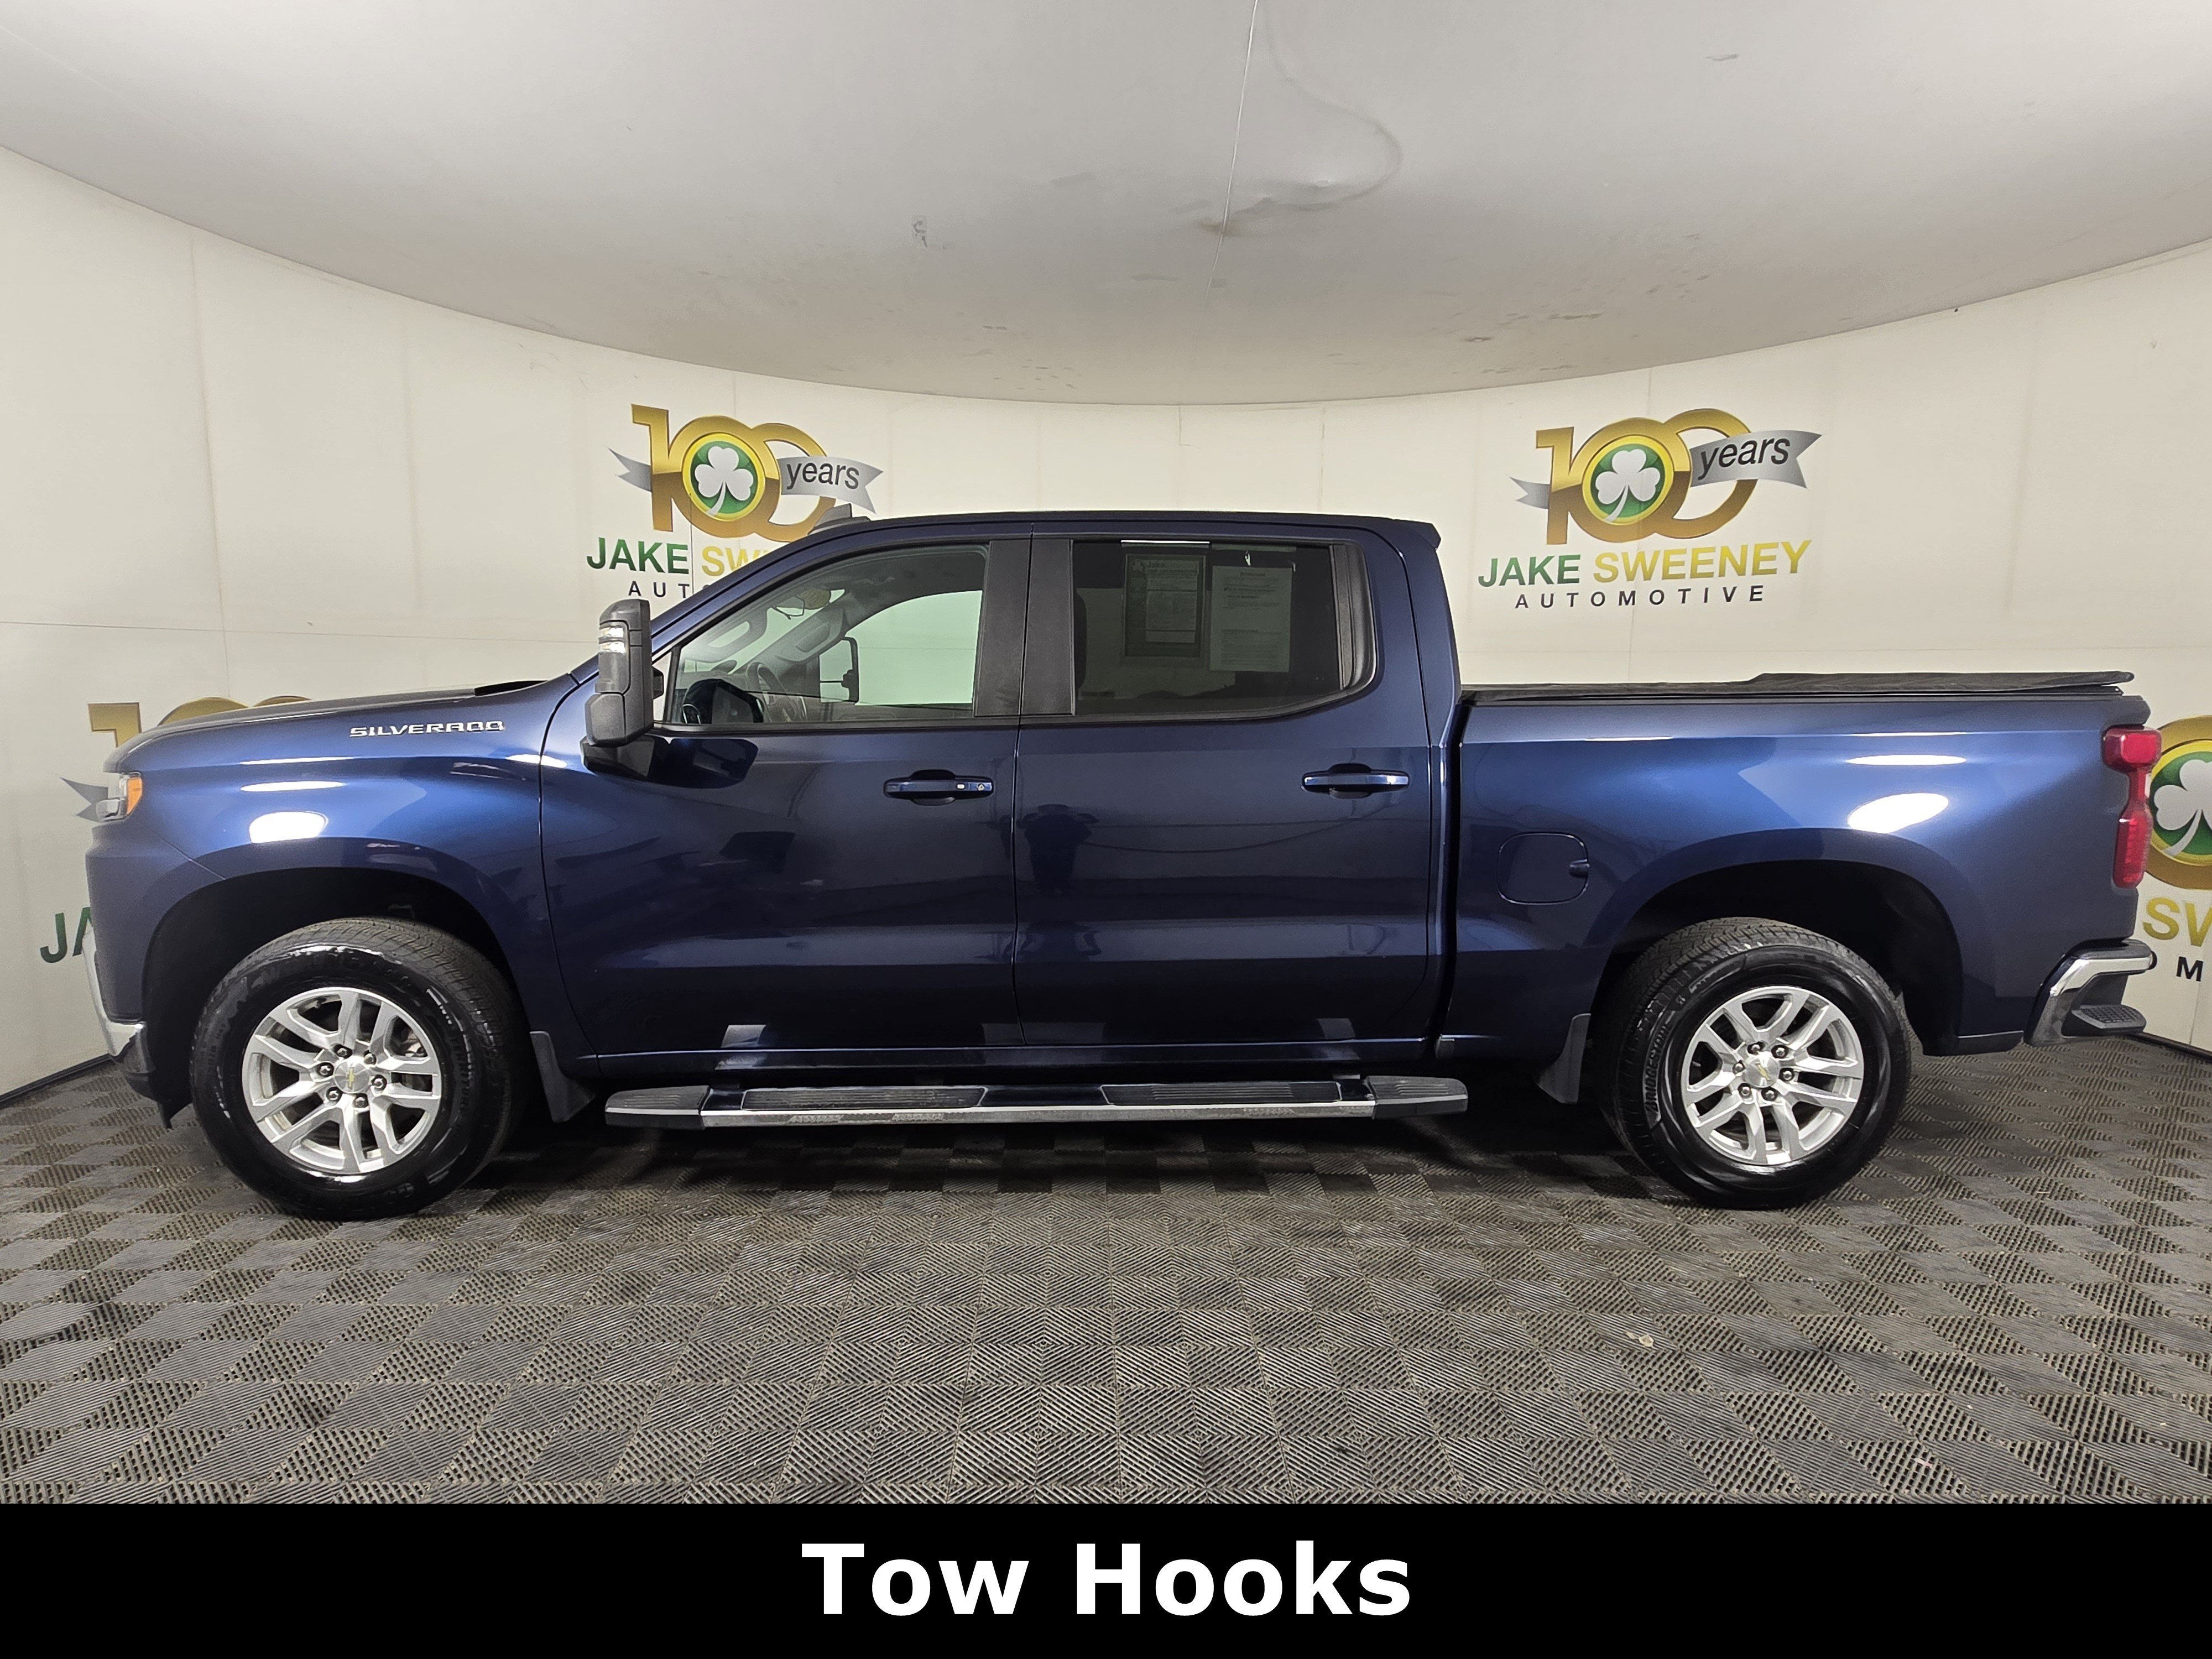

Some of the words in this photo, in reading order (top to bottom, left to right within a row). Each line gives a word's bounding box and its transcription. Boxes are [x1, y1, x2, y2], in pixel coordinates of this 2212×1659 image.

[631, 404, 836, 542] 100
[786, 460, 860, 490] years
[1536, 408, 1761, 545] 100
[1698, 437, 1791, 481] years
[587, 537, 689, 574] JAKE
[1478, 554, 1581, 587] JAKE
[1593, 540, 1812, 583] SWEENEY
[1515, 585, 1764, 609] AUTOMOTIVE
[349, 721, 504, 737] SILVERADO
